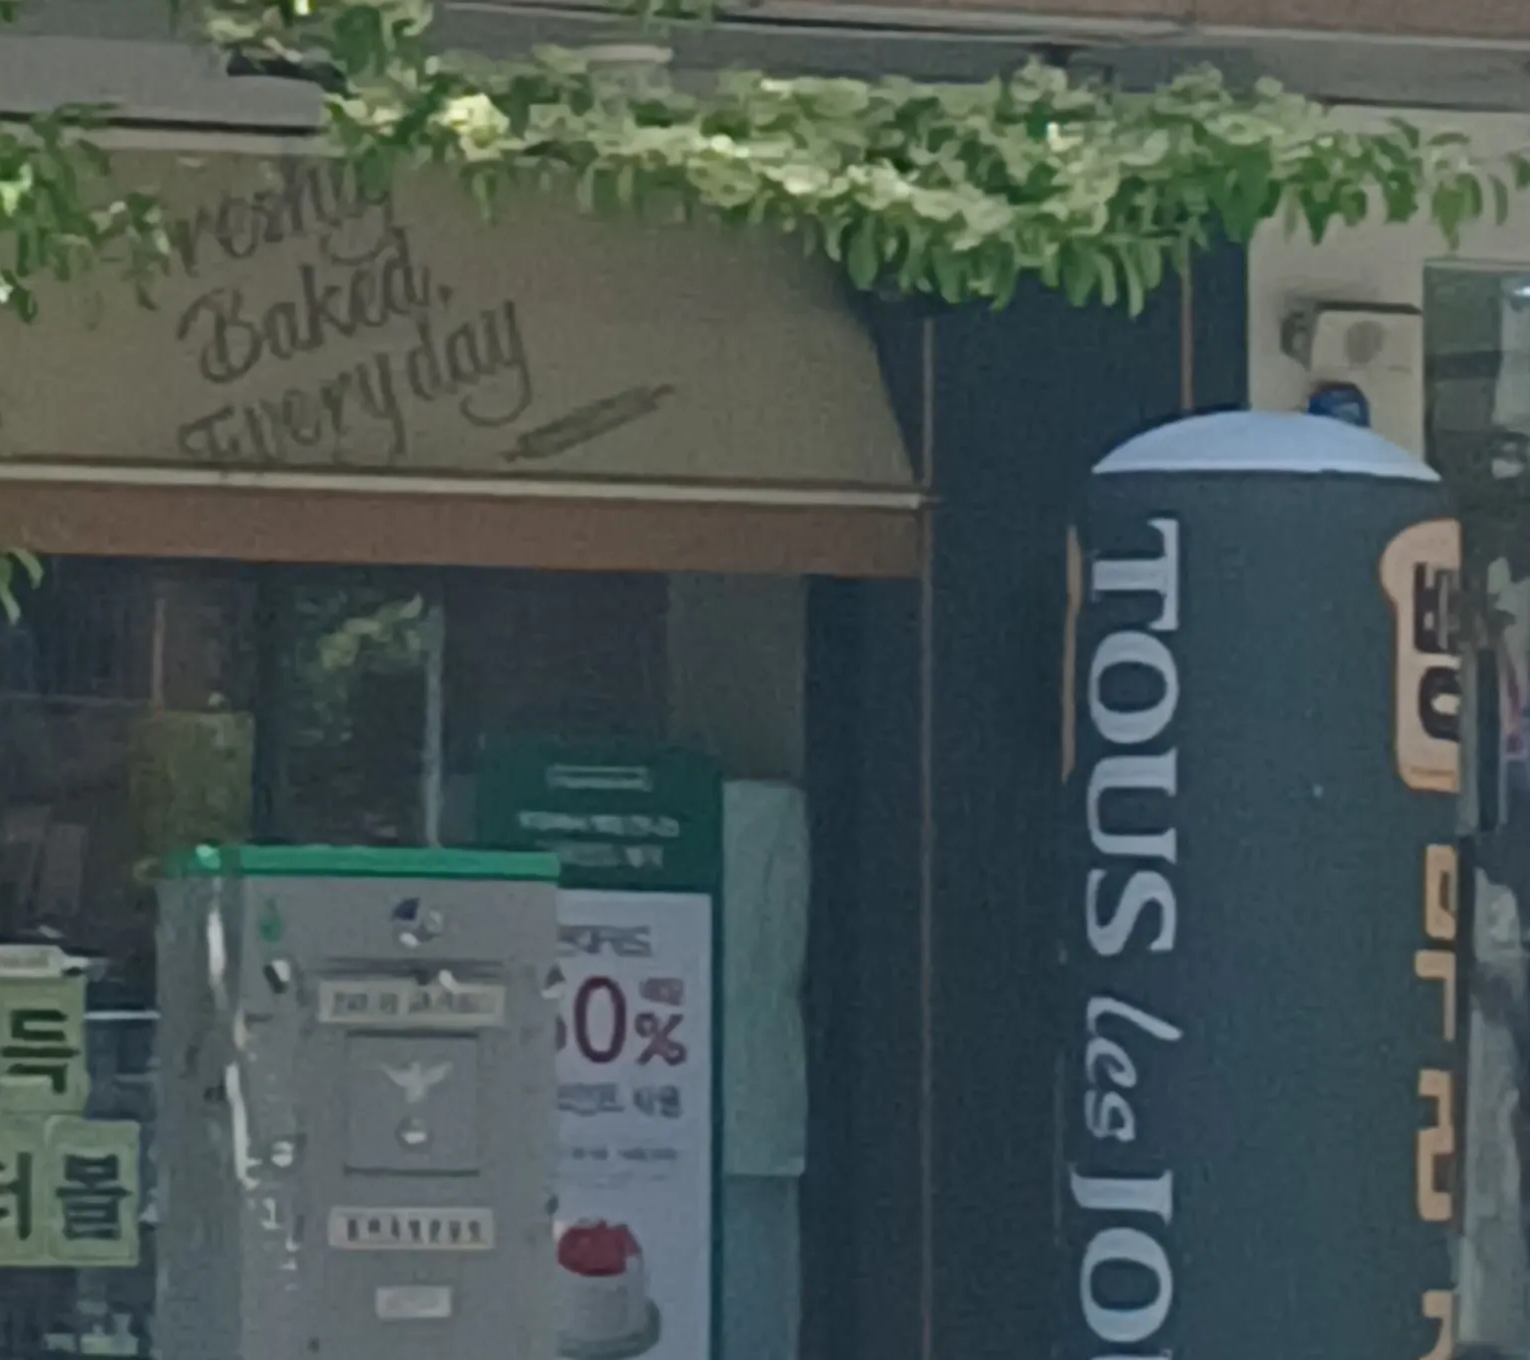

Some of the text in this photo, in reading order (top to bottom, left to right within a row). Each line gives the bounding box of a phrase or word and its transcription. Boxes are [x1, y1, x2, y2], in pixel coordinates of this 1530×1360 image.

[1070, 518, 1184, 1360] TOUS les JO
